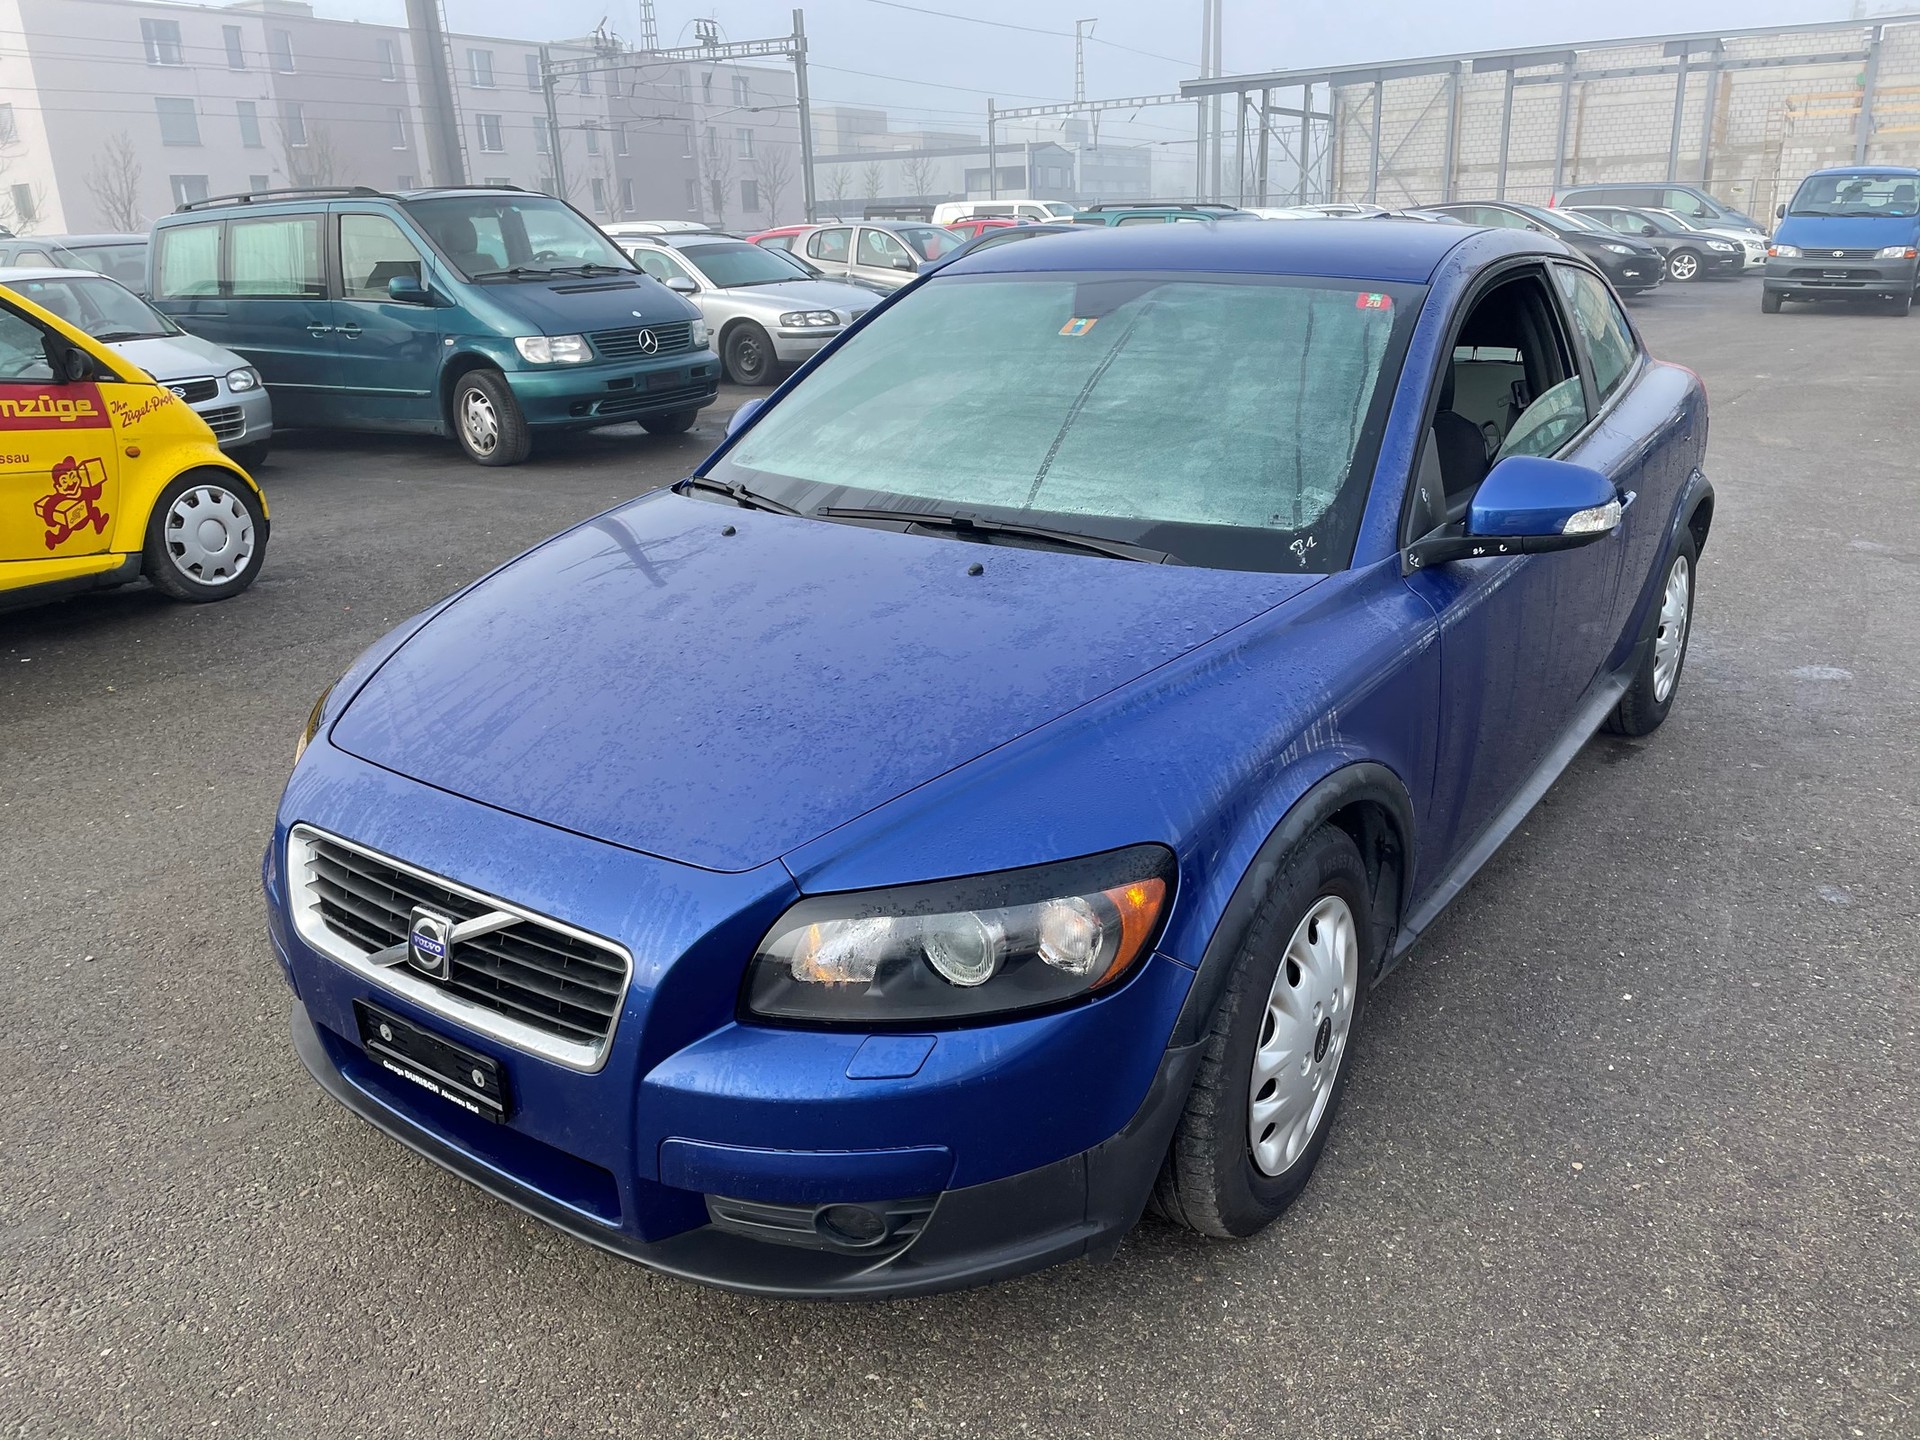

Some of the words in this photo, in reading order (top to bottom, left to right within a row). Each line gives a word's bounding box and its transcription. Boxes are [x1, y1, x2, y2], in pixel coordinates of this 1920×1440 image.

[110, 400, 127, 414] Ihr
[413, 935, 442, 953] VOLVO
[383, 1060, 404, 1076] Garage
